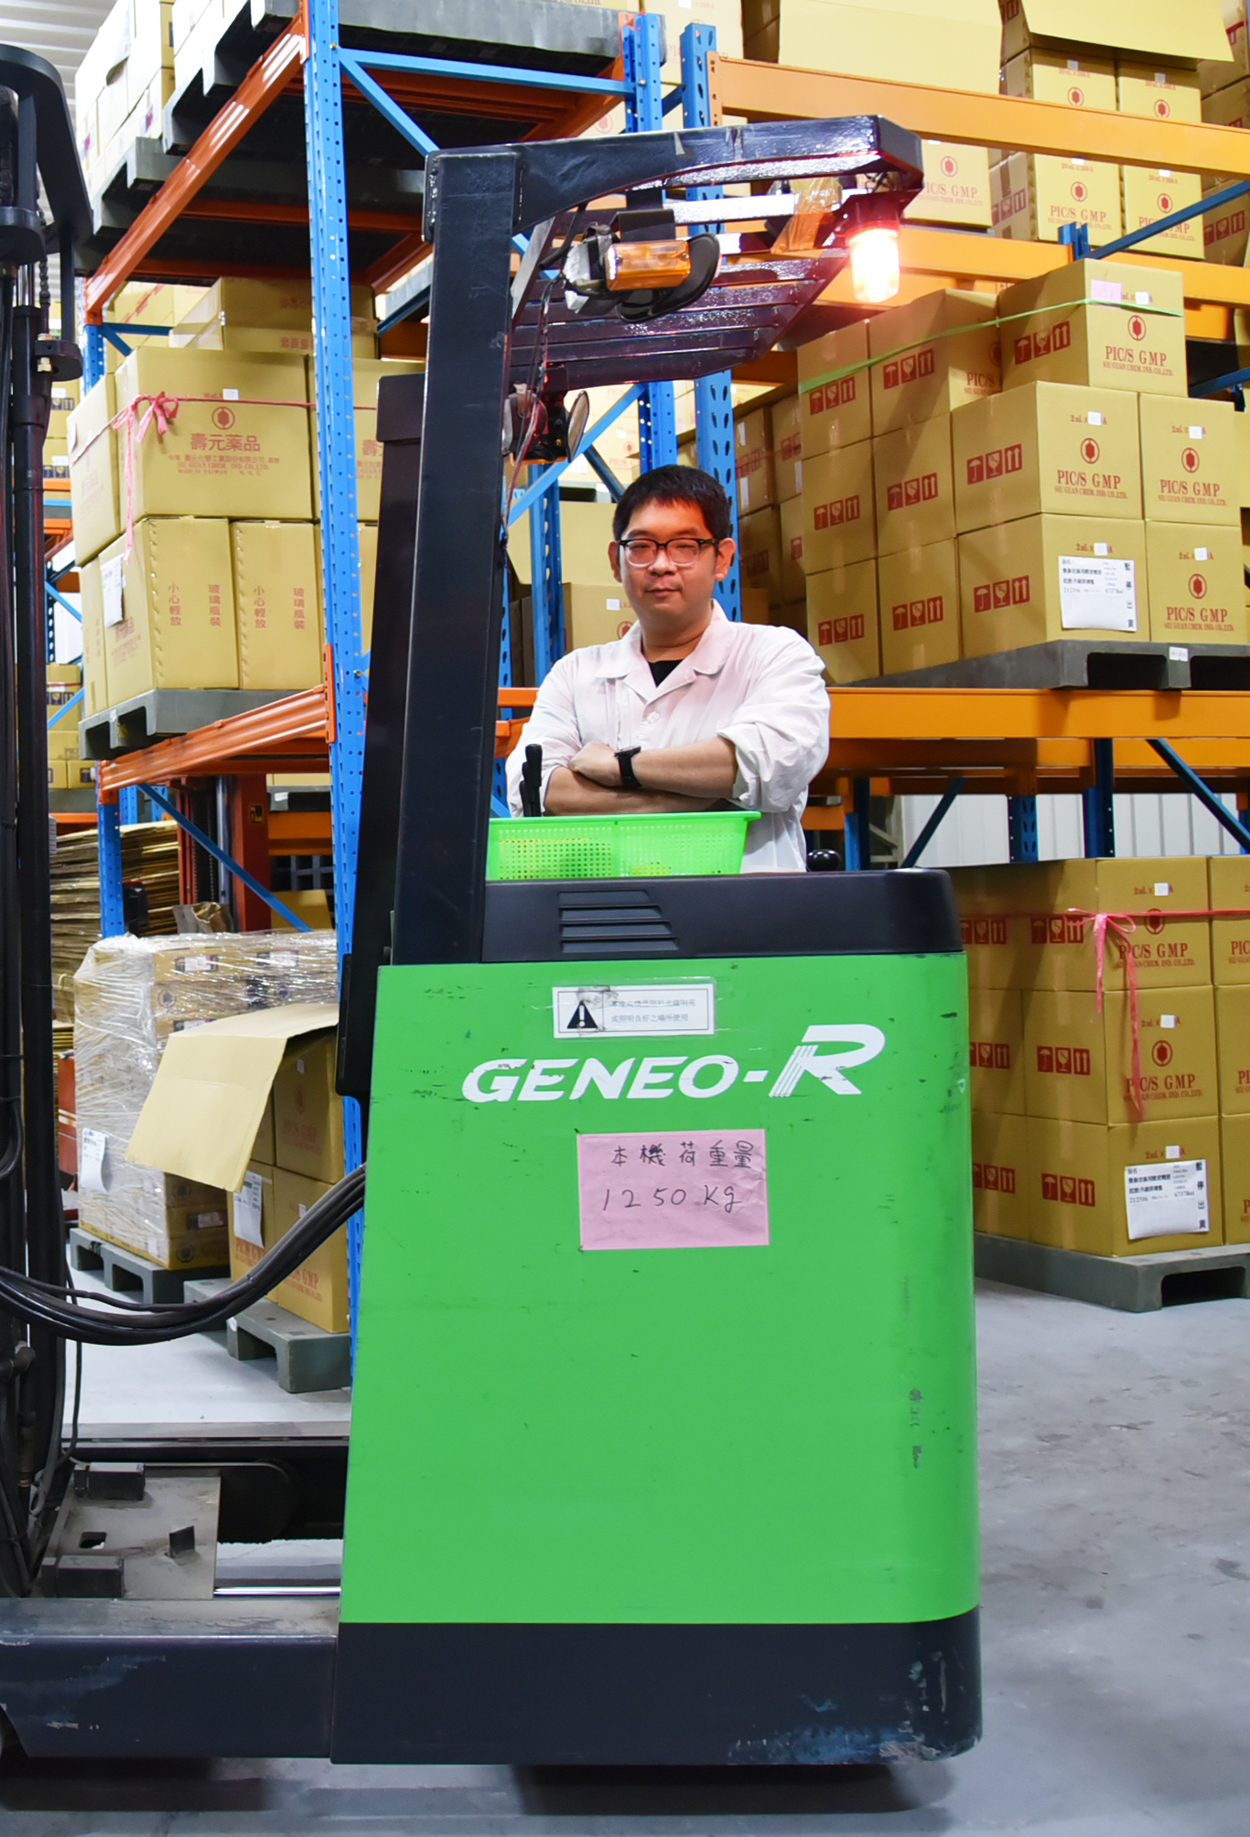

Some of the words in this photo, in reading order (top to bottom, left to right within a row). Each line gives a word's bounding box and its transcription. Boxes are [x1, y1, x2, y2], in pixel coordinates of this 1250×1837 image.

[925, 182, 947, 194] IC/S
[1050, 205, 1076, 218] PIC/S
[1081, 209, 1107, 222] GMP
[1105, 345, 1134, 362] PIC/S
[1139, 350, 1167, 367] GMP
[966, 371, 995, 387] PIC/S
[1057, 469, 1087, 486] PIC/S
[1092, 473, 1121, 490] GMP
[1160, 479, 1188, 495] PIC/S
[1193, 482, 1220, 497] GMP
[168, 582, 182, 626] 小心輕放
[253, 586, 266, 629] 小心輕放
[1166, 606, 1195, 621] PIC/S
[1200, 608, 1228, 623] GMP
[1118, 943, 1151, 960] PC/S
[1157, 942, 1188, 958] GMP
[461, 1023, 886, 1103] GENEO-R
[1125, 1076, 1158, 1094] PC/S
[1164, 1073, 1196, 1090] GMP
[611, 1139, 754, 1169] 本機荷重量
[602, 1187, 687, 1211] 1250
